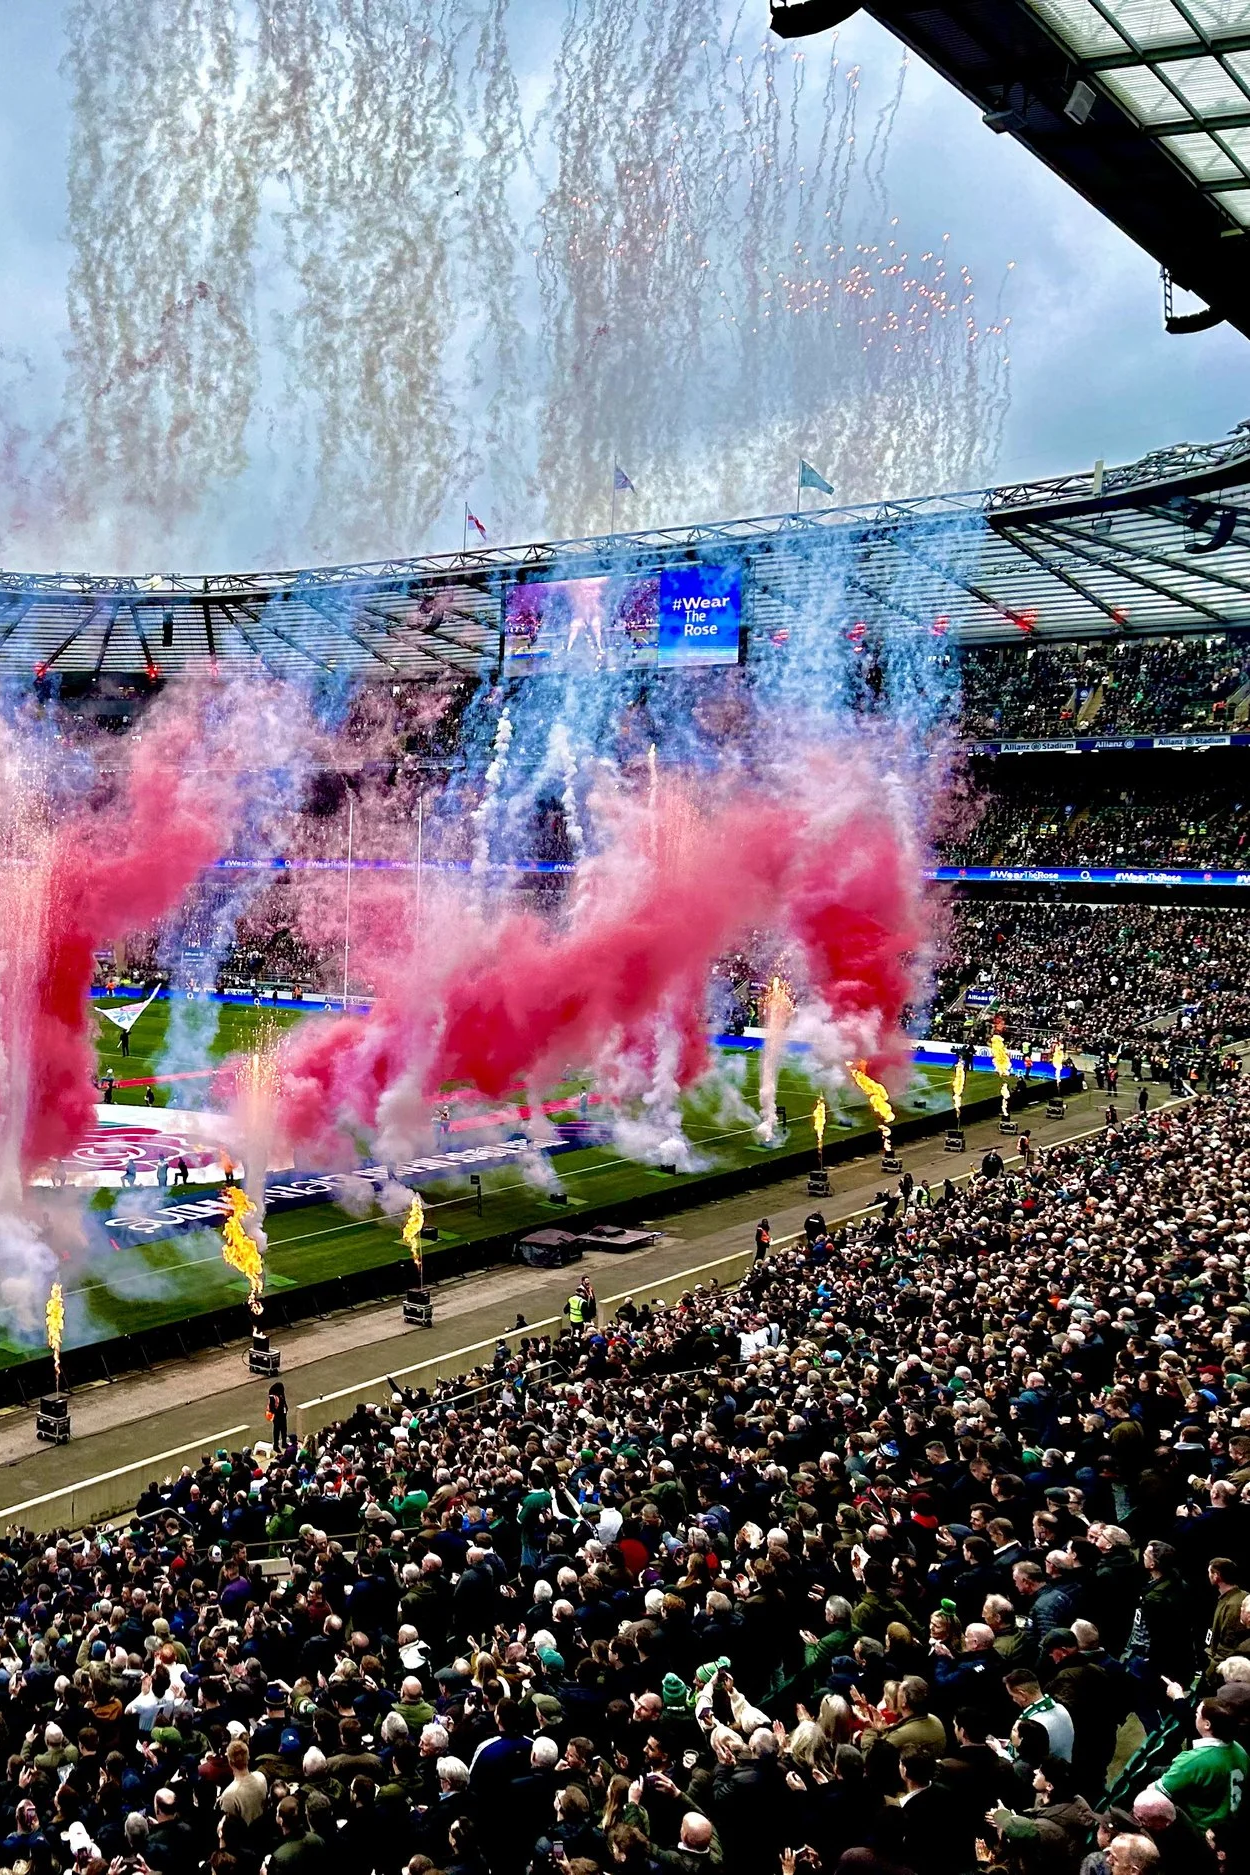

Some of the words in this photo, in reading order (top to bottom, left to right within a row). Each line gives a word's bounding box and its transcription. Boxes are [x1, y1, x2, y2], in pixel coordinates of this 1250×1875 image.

[672, 596, 730, 611] #Wear
[684, 610, 707, 623] The
[684, 623, 718, 637] Rose
[1004, 743, 1030, 751] Allianz
[1042, 742, 1074, 750] Stadium
[1095, 741, 1123, 749] Allianz
[1159, 738, 1184, 747] Allianz
[1195, 736, 1227, 745] Stadium
[990, 870, 1060, 880] #WearTheRose
[1114, 872, 1182, 883] #WearTheRose
